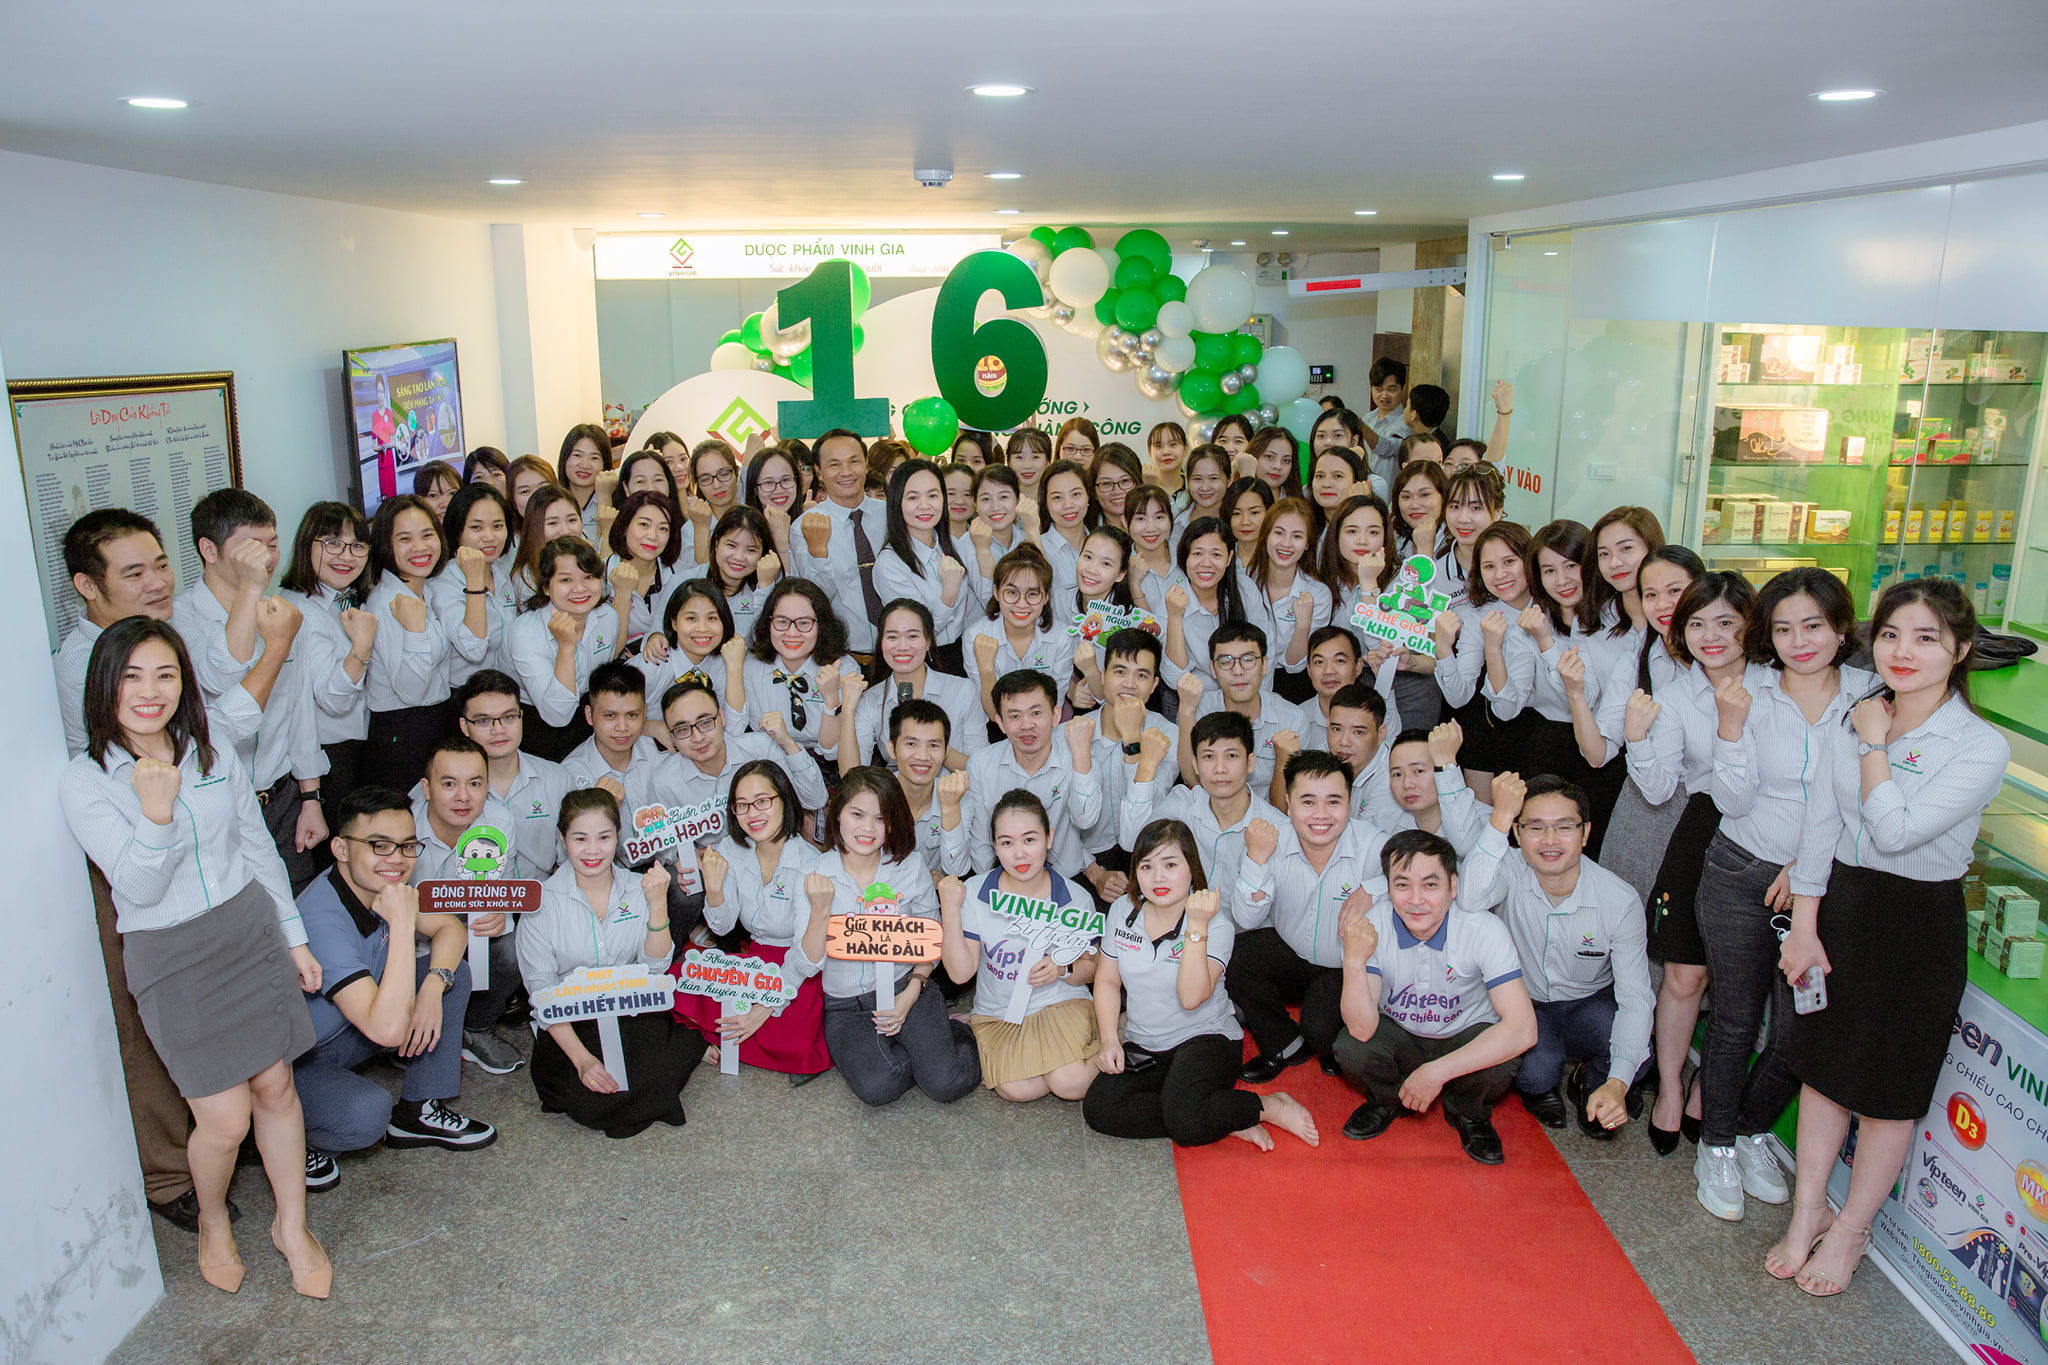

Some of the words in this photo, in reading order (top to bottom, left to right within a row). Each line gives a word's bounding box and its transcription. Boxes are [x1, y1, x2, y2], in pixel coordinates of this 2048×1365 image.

[745, 242, 787, 259] DƯỢC
[793, 237, 834, 255] PHẨM
[841, 244, 874, 255] VINH
[880, 243, 905, 255] GIA
[1517, 467, 1541, 494] VÀO
[1112, 606, 1123, 616] LÀ
[1377, 609, 1401, 626] THẾ
[1400, 619, 1427, 636] GIỚI
[1366, 621, 1398, 640] KHO
[667, 806, 698, 825] Buôn
[700, 802, 711, 813] có
[627, 836, 663, 860] Bán
[663, 834, 675, 846] có
[675, 813, 721, 842] Hàng
[510, 886, 526, 898] VG
[511, 900, 523, 908] TA
[991, 891, 1056, 923] VINH
[1060, 908, 1105, 934] GIA
[843, 917, 872, 942] Giữ
[872, 918, 925, 934] KHÁCH
[880, 933, 891, 942] LÀ
[1004, 912, 1096, 965] Birthday
[846, 940, 888, 956] HÀNG
[892, 940, 925, 957] ĐẦU
[982, 939, 1026, 968] Vipt
[555, 984, 582, 997] LÀM
[617, 977, 648, 990] TÌNH
[586, 969, 613, 981] MKT
[686, 963, 749, 987] CHUYÊN
[754, 972, 782, 992] GIA
[543, 1002, 580, 1019] chơi
[582, 993, 616, 1014] HẾT
[618, 991, 666, 1009] MÌNH
[1387, 983, 1461, 1009] Vipteen
[1944, 1052, 1953, 1064] G
[1996, 1094, 2024, 1120] CAO
[2026, 1117, 2048, 1143] CH
[1922, 1151, 1967, 1202] Vipteen
[1880, 1220, 1911, 1256] Website:
[1912, 1236, 1996, 1328] 1800.55.88.89
